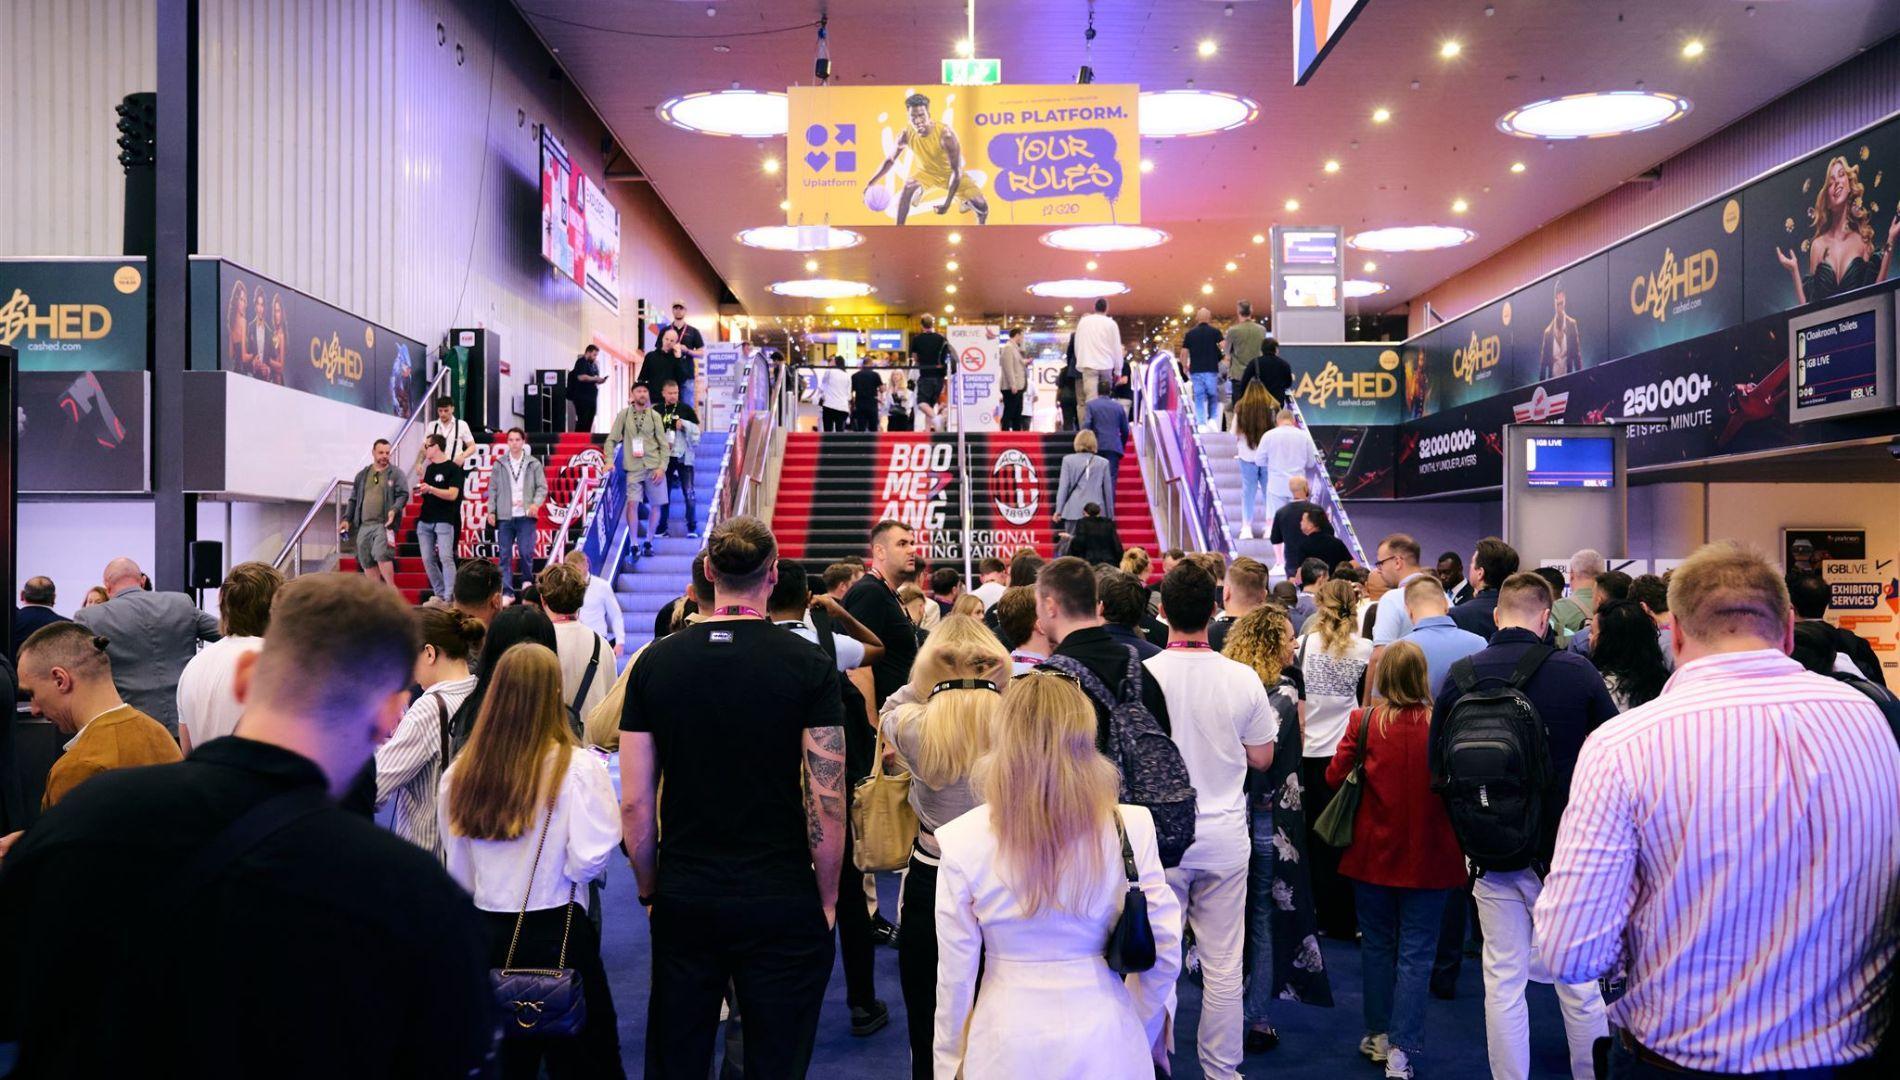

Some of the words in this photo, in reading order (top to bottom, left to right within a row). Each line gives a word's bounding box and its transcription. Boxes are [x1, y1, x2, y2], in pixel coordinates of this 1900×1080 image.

[975, 112, 1015, 126] OUR
[1021, 106, 1128, 123] PLATFORM.
[1015, 135, 1095, 165] YOUR
[803, 178, 857, 188] Uplatform
[1008, 163, 1114, 195] RULES
[1673, 299, 1702, 314] cashed.com
[1807, 326, 1838, 341] Cloakroom,
[1839, 321, 1858, 332] Toilets
[27, 342, 82, 352] cashed.com
[1337, 398, 1376, 407] cashed.com
[1671, 409, 1712, 430] MINUTE
[889, 443, 953, 472] BOO
[1002, 451, 1028, 465] ACM
[879, 501, 947, 529] ANG
[1005, 508, 1031, 518] 1899
[913, 530, 956, 544] ICIAL
[914, 544, 958, 558] TING
[969, 544, 1035, 558] ARTN
[1832, 585, 1880, 595] EXHIBITOR
[1832, 595, 1875, 606] SERVICES
